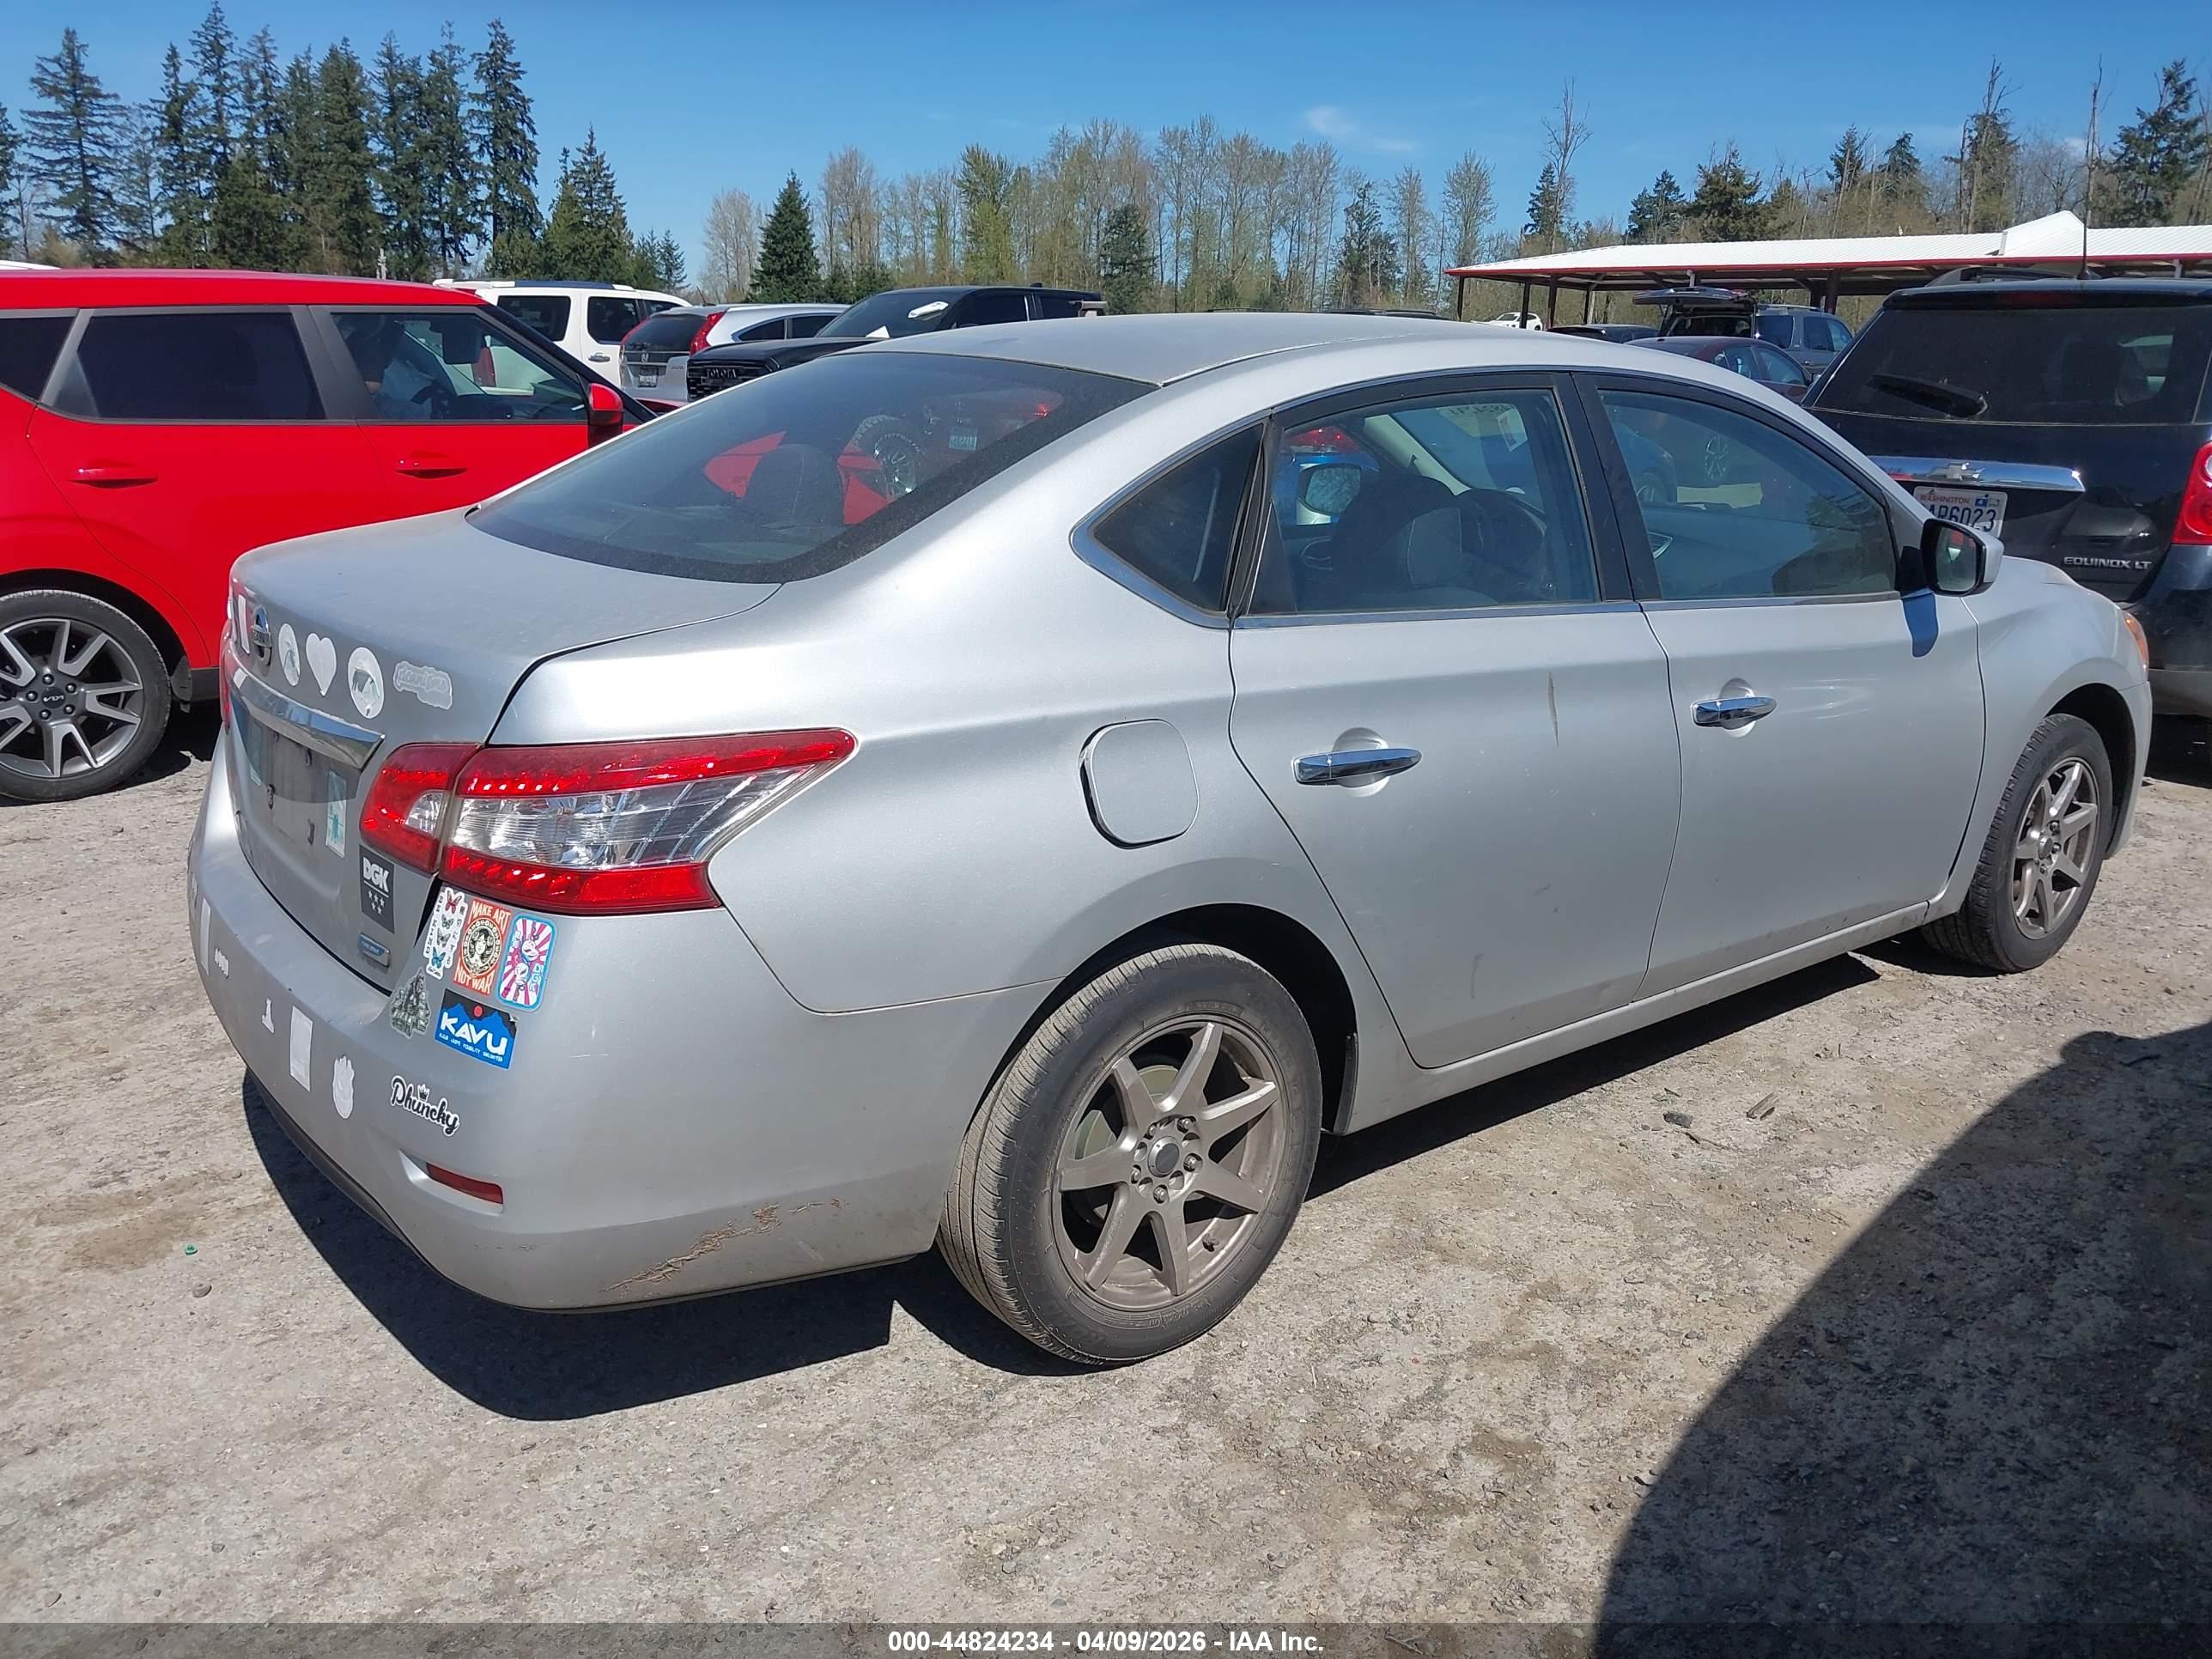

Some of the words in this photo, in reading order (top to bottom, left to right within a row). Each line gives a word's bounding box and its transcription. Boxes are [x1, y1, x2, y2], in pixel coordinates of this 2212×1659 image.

[707, 368, 736, 378] TOYOTA
[1919, 494, 1970, 504] WASHINGTON
[2063, 556, 2130, 568] EQUINOX
[2135, 561, 2152, 569] LT
[363, 857, 389, 893] DGK
[468, 901, 493, 925] MAKE
[493, 908, 512, 934] ART
[454, 958, 471, 987] NOT
[471, 969, 495, 994] WAR
[441, 1012, 507, 1055] KAVU
[392, 1076, 459, 1135] Phuncky
